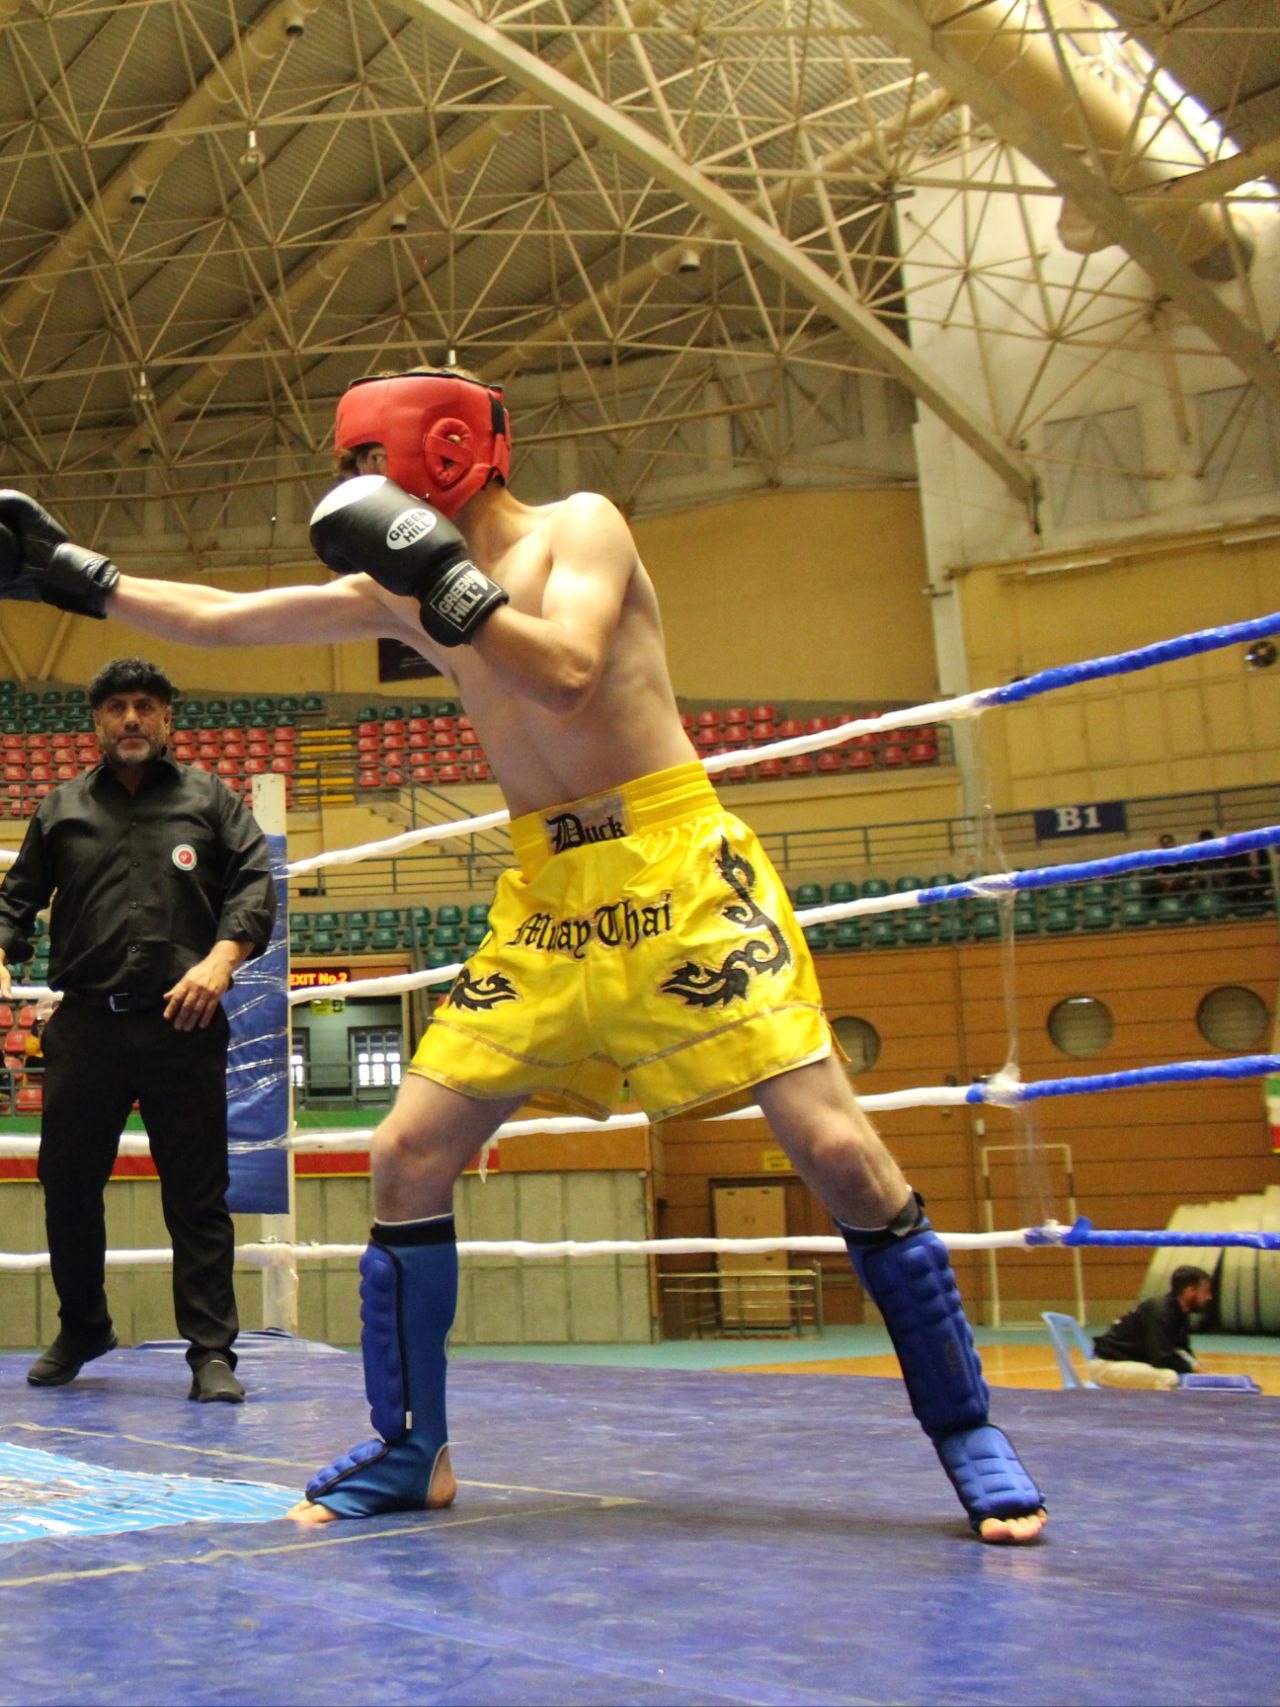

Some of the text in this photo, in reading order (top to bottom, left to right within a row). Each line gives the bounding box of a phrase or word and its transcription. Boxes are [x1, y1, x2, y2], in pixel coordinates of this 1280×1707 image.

[389, 511, 428, 541] GREEN
[403, 517, 432, 542] HILL
[438, 575, 475, 614] GREEN
[449, 590, 483, 622] HILL
[546, 813, 627, 854] Duck
[1055, 806, 1102, 832] B1
[505, 890, 673, 959] Muay Thai
[289, 973, 316, 985] EXIT
